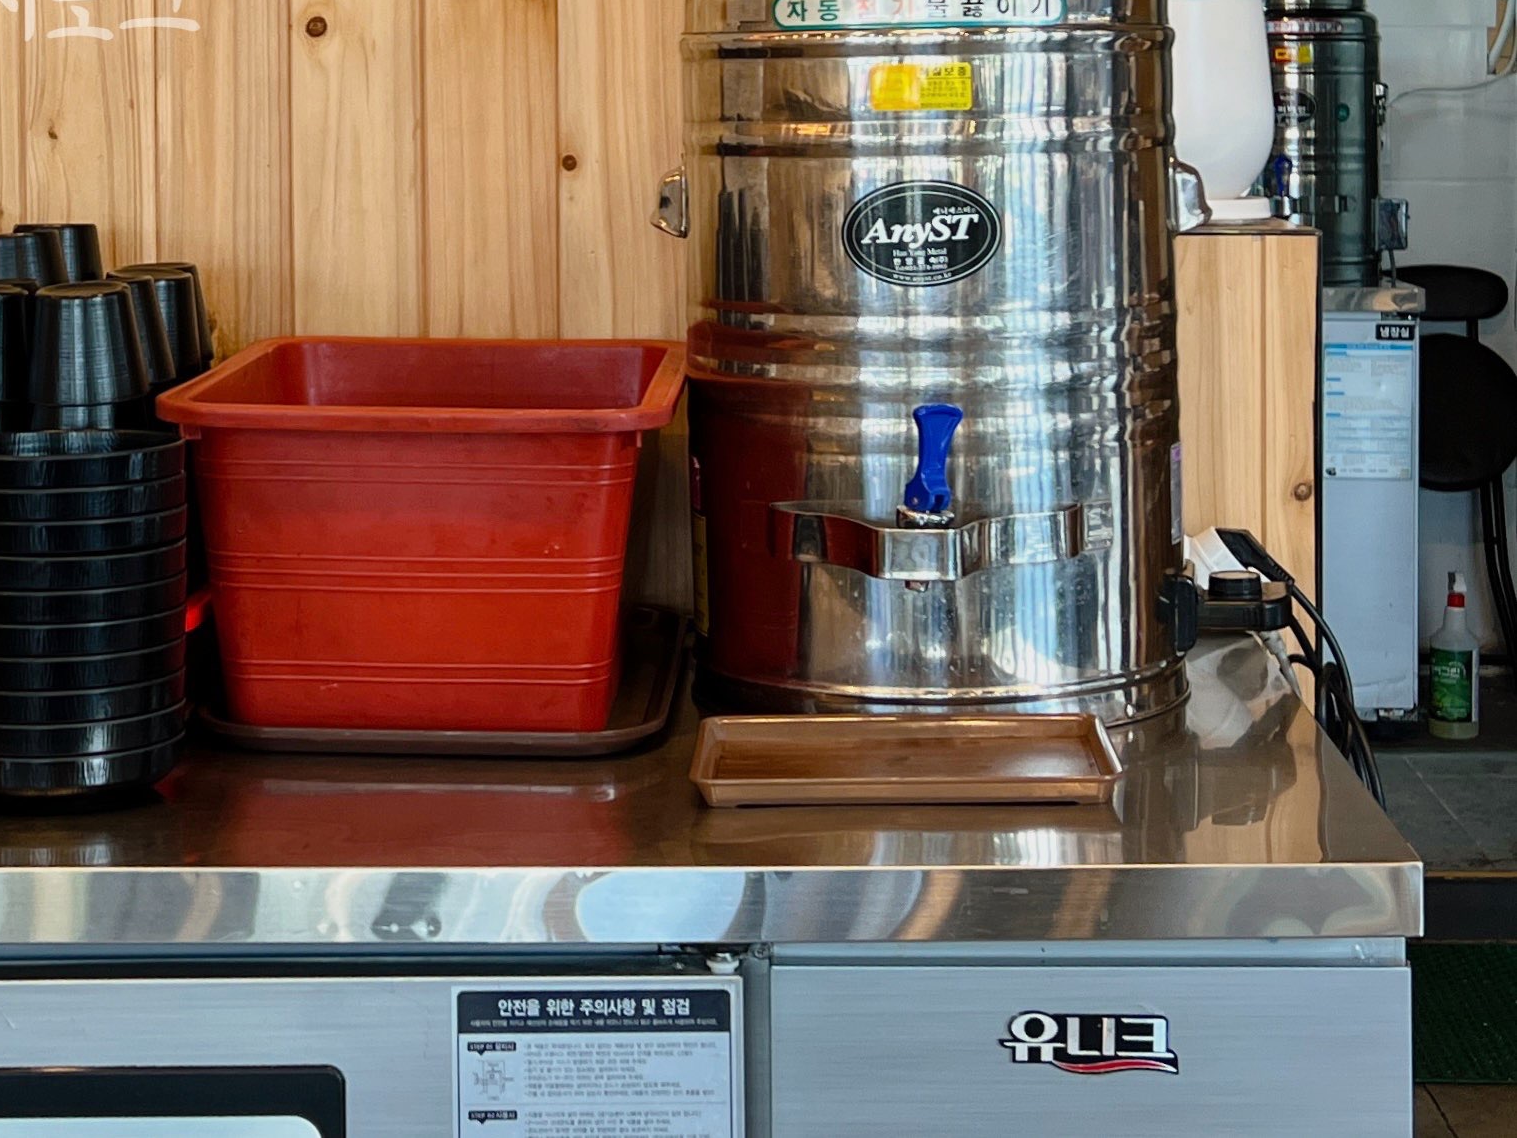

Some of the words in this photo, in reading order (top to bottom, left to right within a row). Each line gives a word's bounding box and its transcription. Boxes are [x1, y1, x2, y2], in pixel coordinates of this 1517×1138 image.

[861, 214, 979, 249] AnyST
[498, 998, 540, 1016] 안전을
[546, 998, 575, 1016] 위한
[579, 998, 636, 1015] 주의사항
[641, 998, 656, 1015] 및
[661, 998, 690, 1014] 점검
[1003, 1013, 1175, 1062] 유니크
